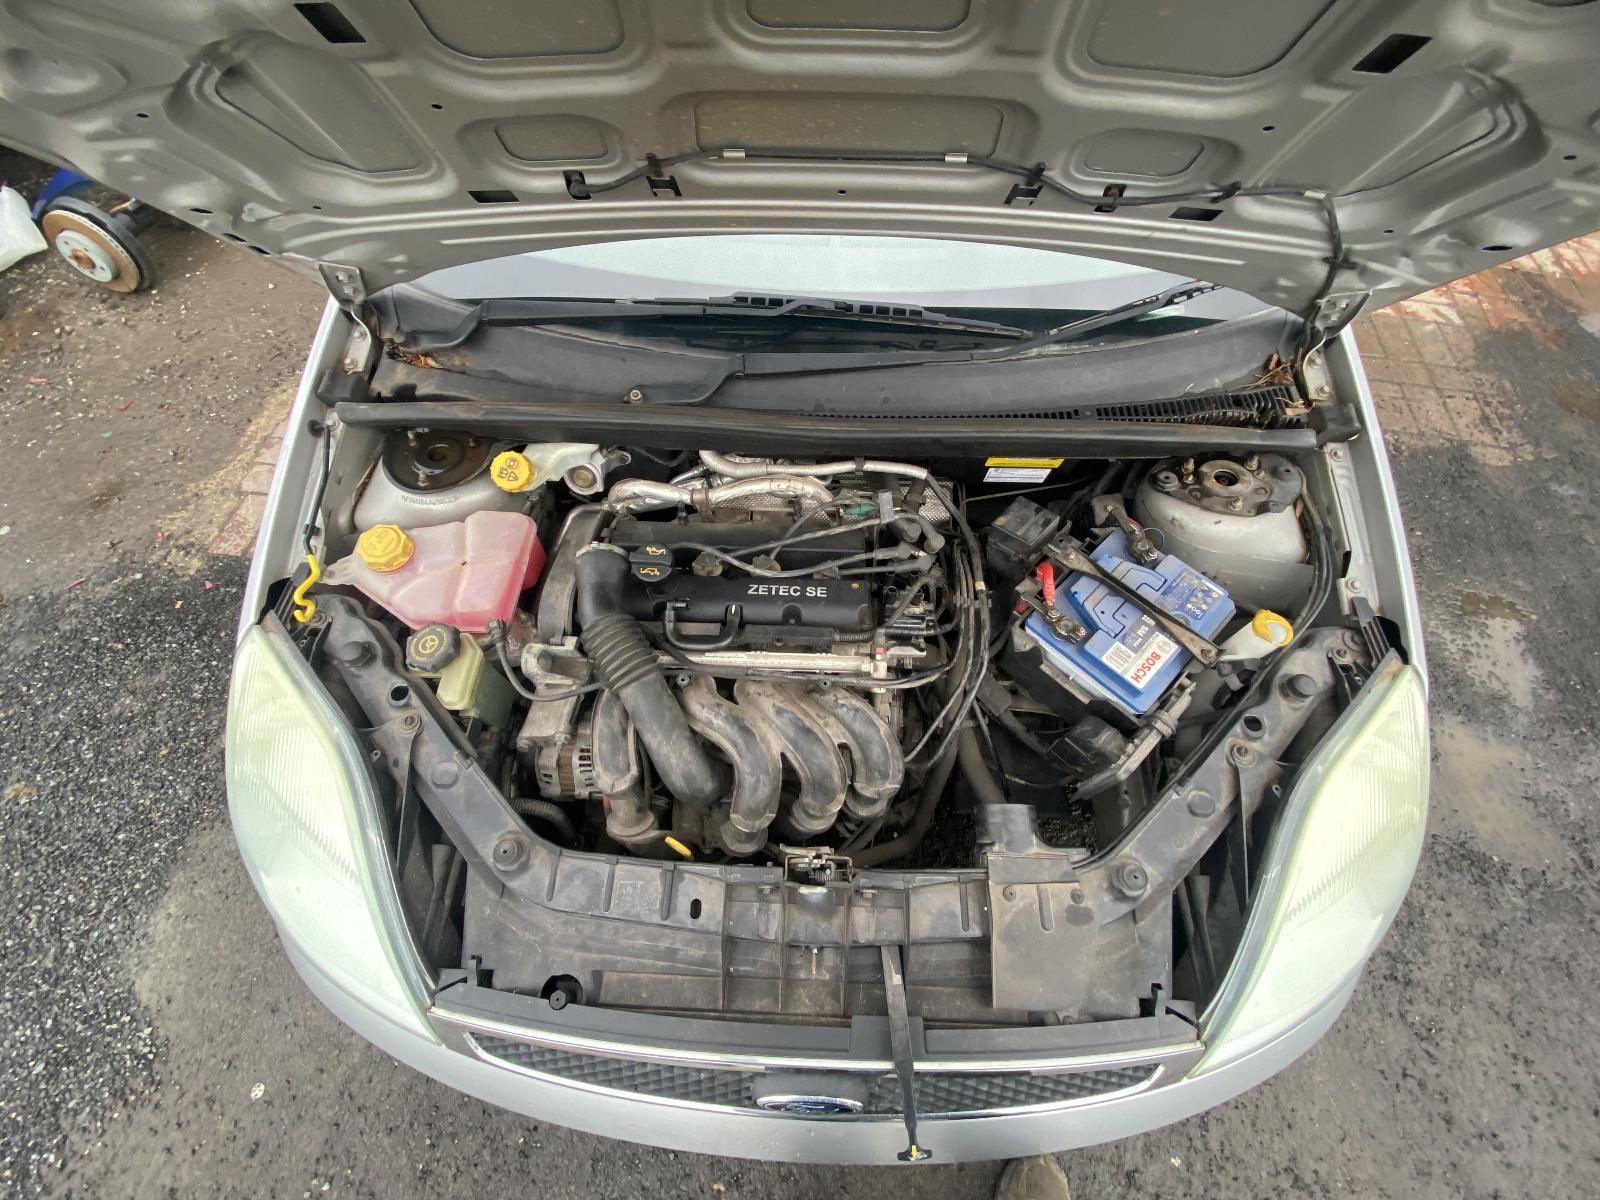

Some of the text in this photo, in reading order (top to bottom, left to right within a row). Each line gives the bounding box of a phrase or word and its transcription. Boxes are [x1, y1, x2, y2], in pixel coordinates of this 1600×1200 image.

[747, 584, 827, 598] ZETEC SE
[1131, 651, 1161, 684] BOSCH
